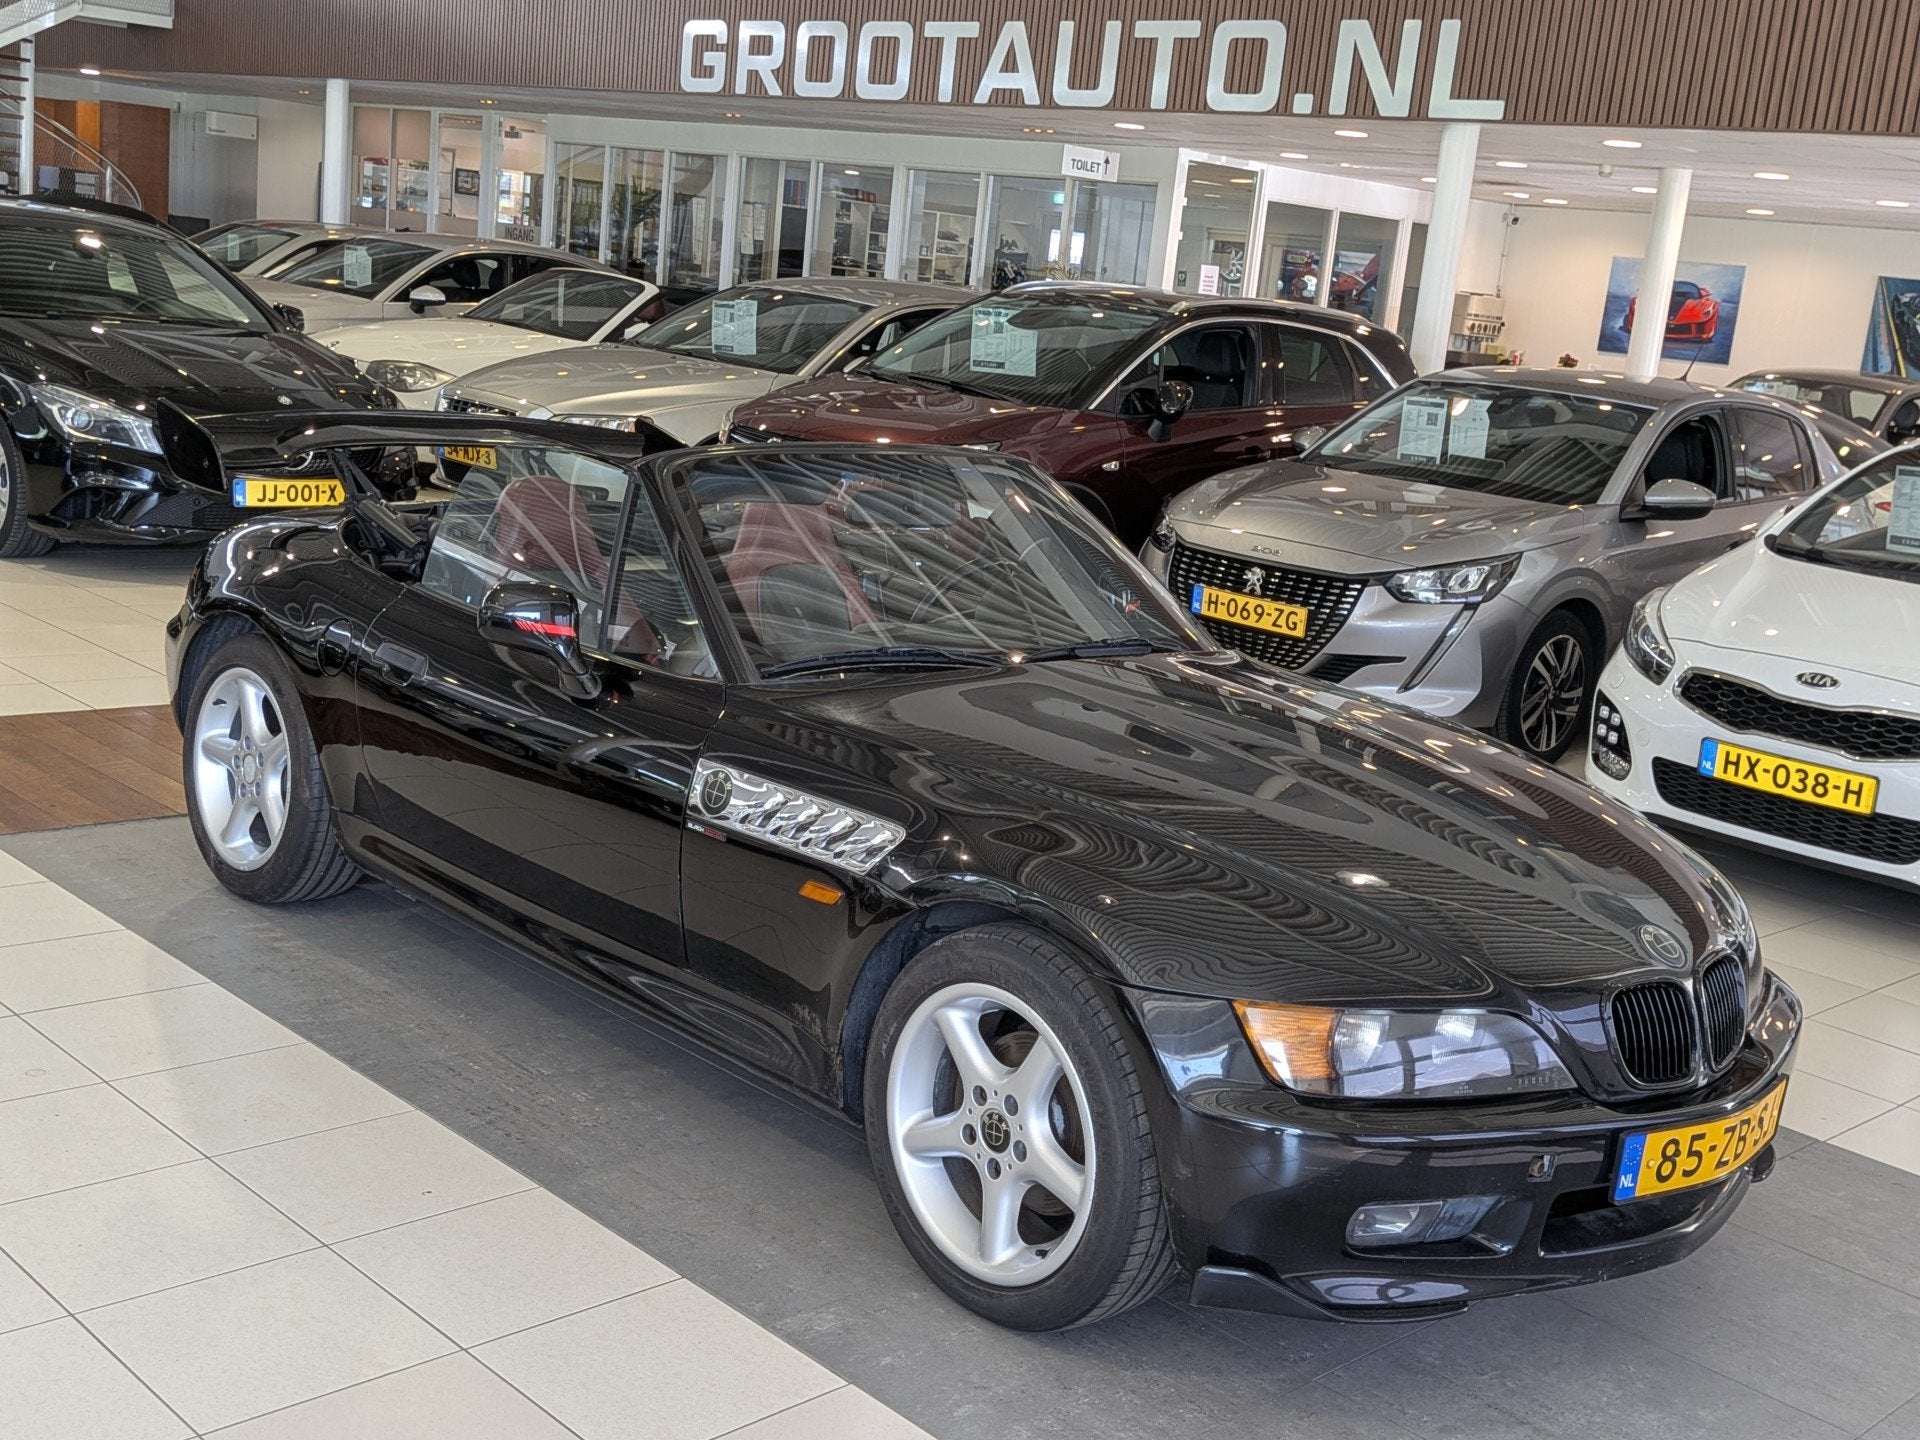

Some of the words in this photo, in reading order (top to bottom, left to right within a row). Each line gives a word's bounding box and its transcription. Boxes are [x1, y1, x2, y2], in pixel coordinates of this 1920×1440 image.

[680, 19, 1505, 120] GROOTAUTO.NL
[1071, 158, 1101, 173] TOILET
[504, 226, 535, 242] INGANG
[257, 484, 338, 502] JJ-001-X
[1207, 592, 1299, 631] H-069-ZG
[1801, 672, 1833, 687] KIA
[1702, 760, 1713, 770] NL
[1723, 750, 1864, 807] HX-038-H
[983, 1113, 1010, 1131] BMW
[1619, 1174, 1635, 1189] NL
